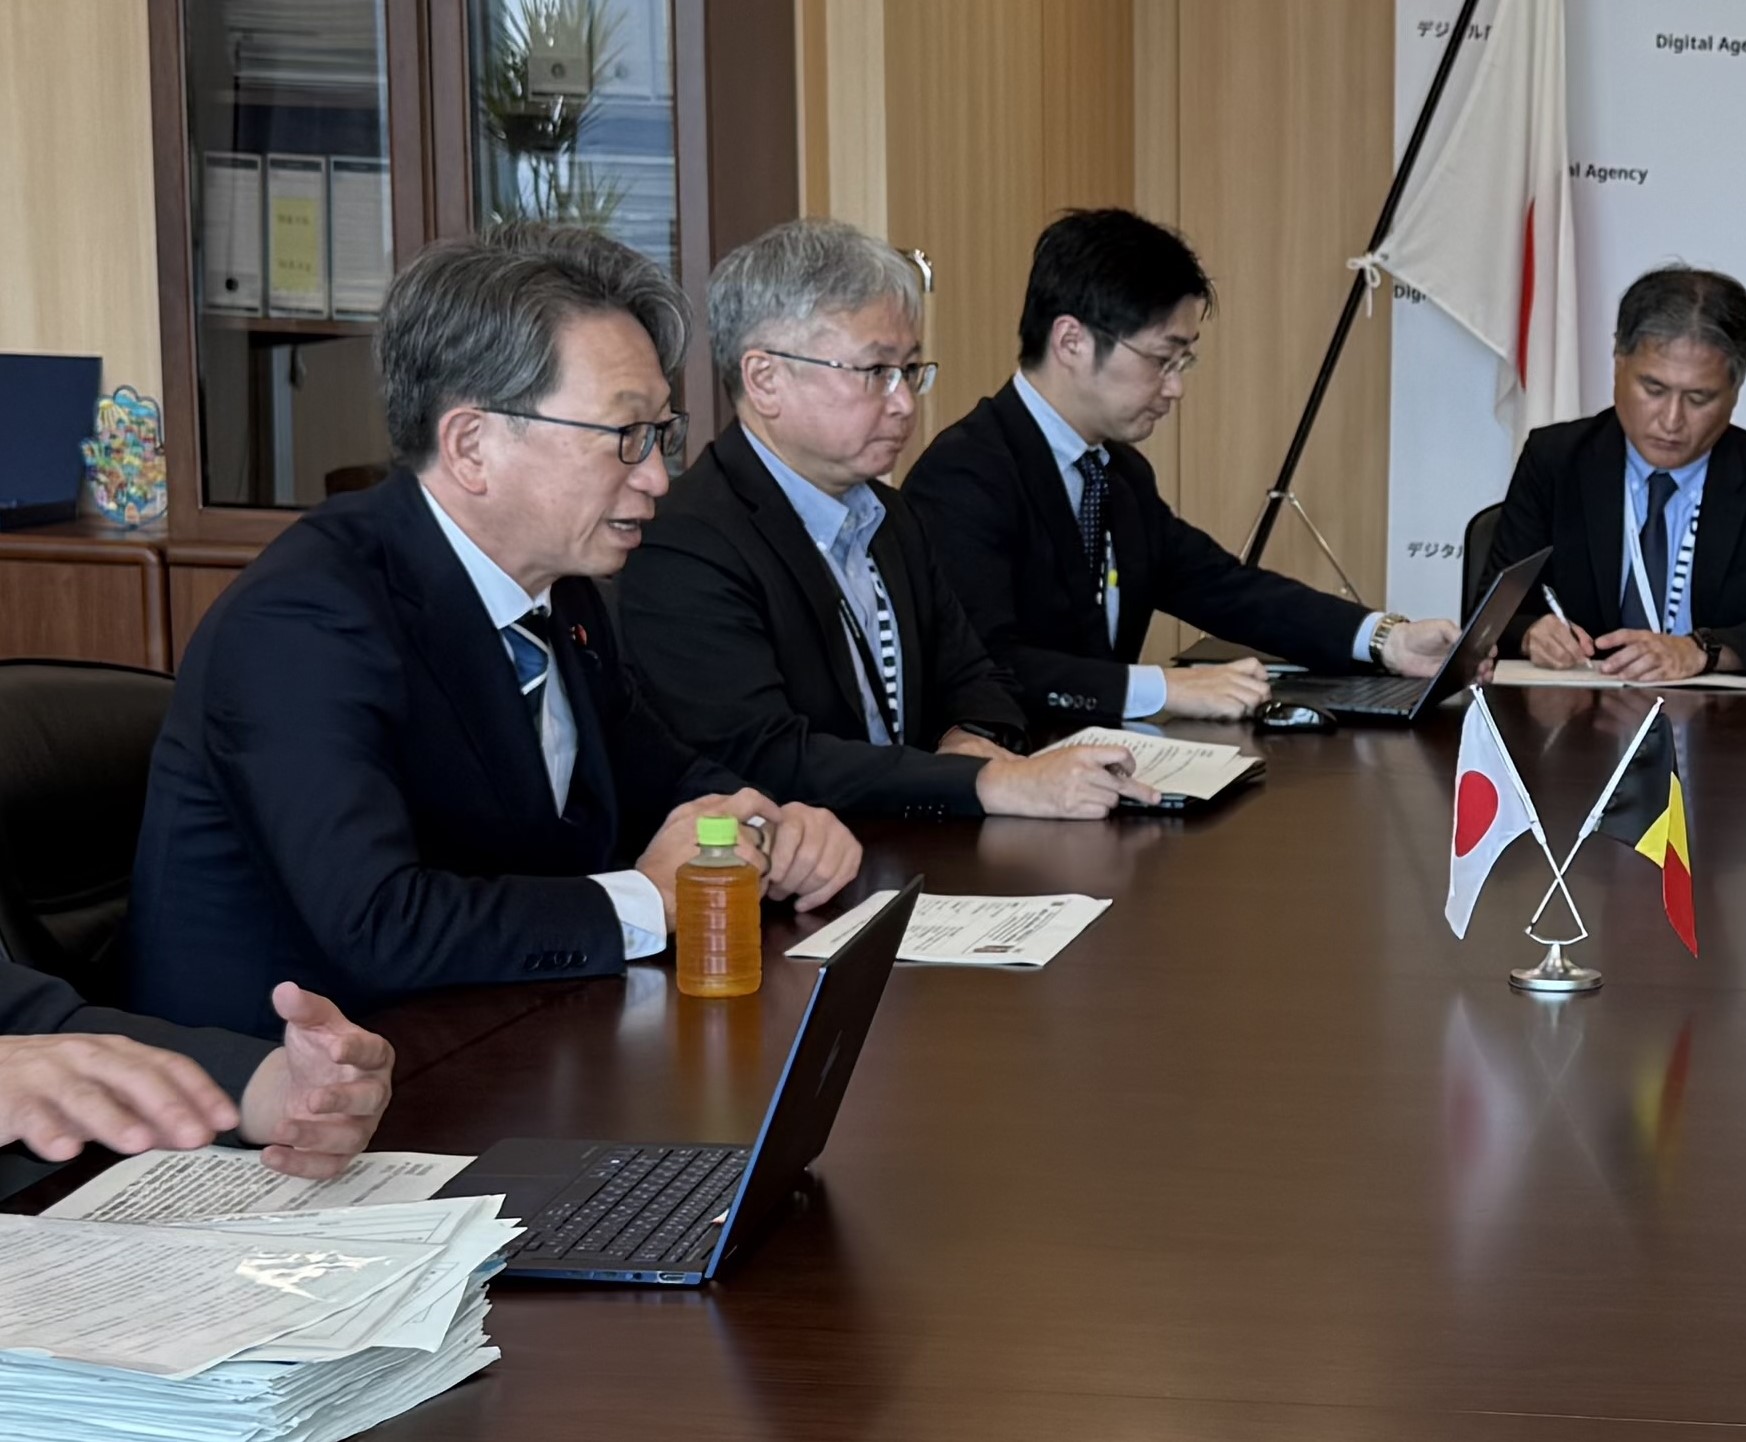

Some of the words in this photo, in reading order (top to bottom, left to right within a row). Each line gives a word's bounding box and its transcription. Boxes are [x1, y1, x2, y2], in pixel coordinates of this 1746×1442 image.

[1416, 20, 1492, 41] デジル
[1655, 32, 1714, 55] Digital
[1584, 163, 1649, 186] Agency
[1406, 541, 1464, 559] デジタ
